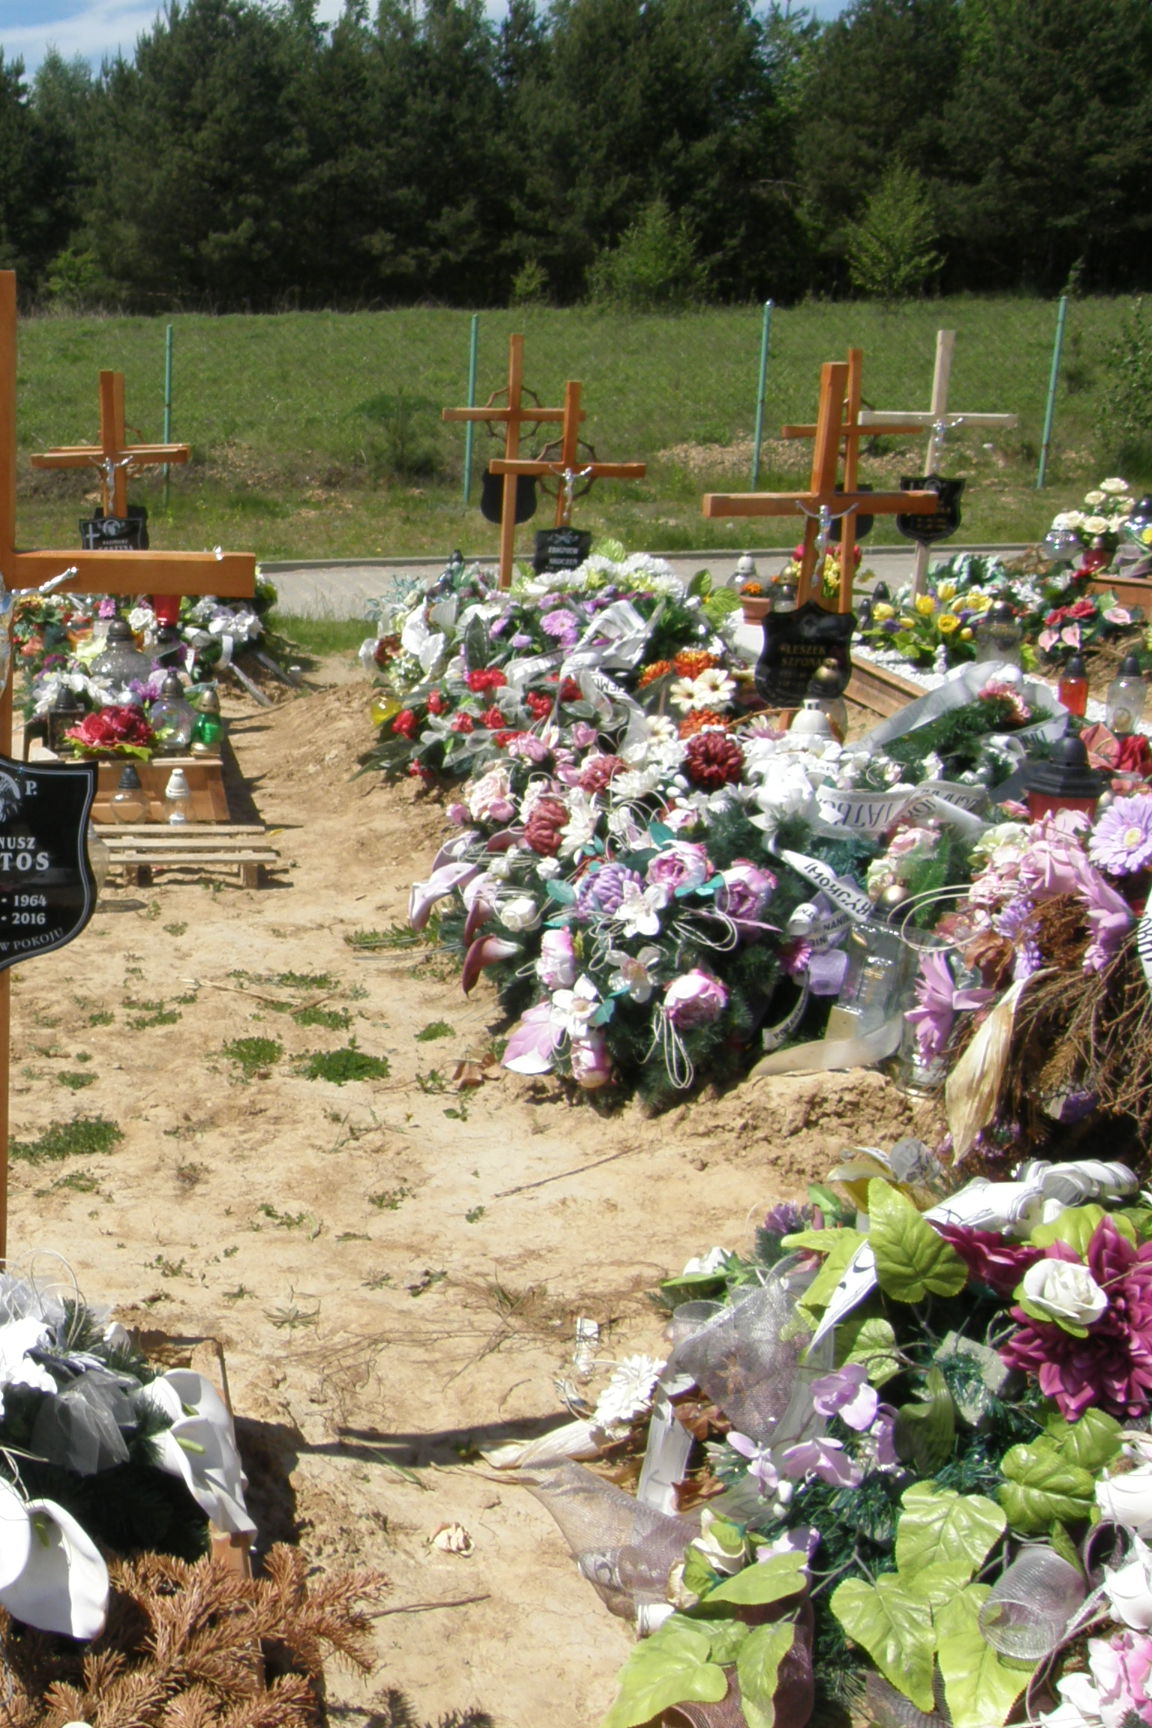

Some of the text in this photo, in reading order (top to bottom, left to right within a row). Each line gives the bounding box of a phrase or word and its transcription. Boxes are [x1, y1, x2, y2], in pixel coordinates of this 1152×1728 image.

[25, 780, 38, 796] P.
[13, 894, 47, 907] 1964
[11, 912, 46, 925] 2016
[13, 926, 64, 950] POKOJU
